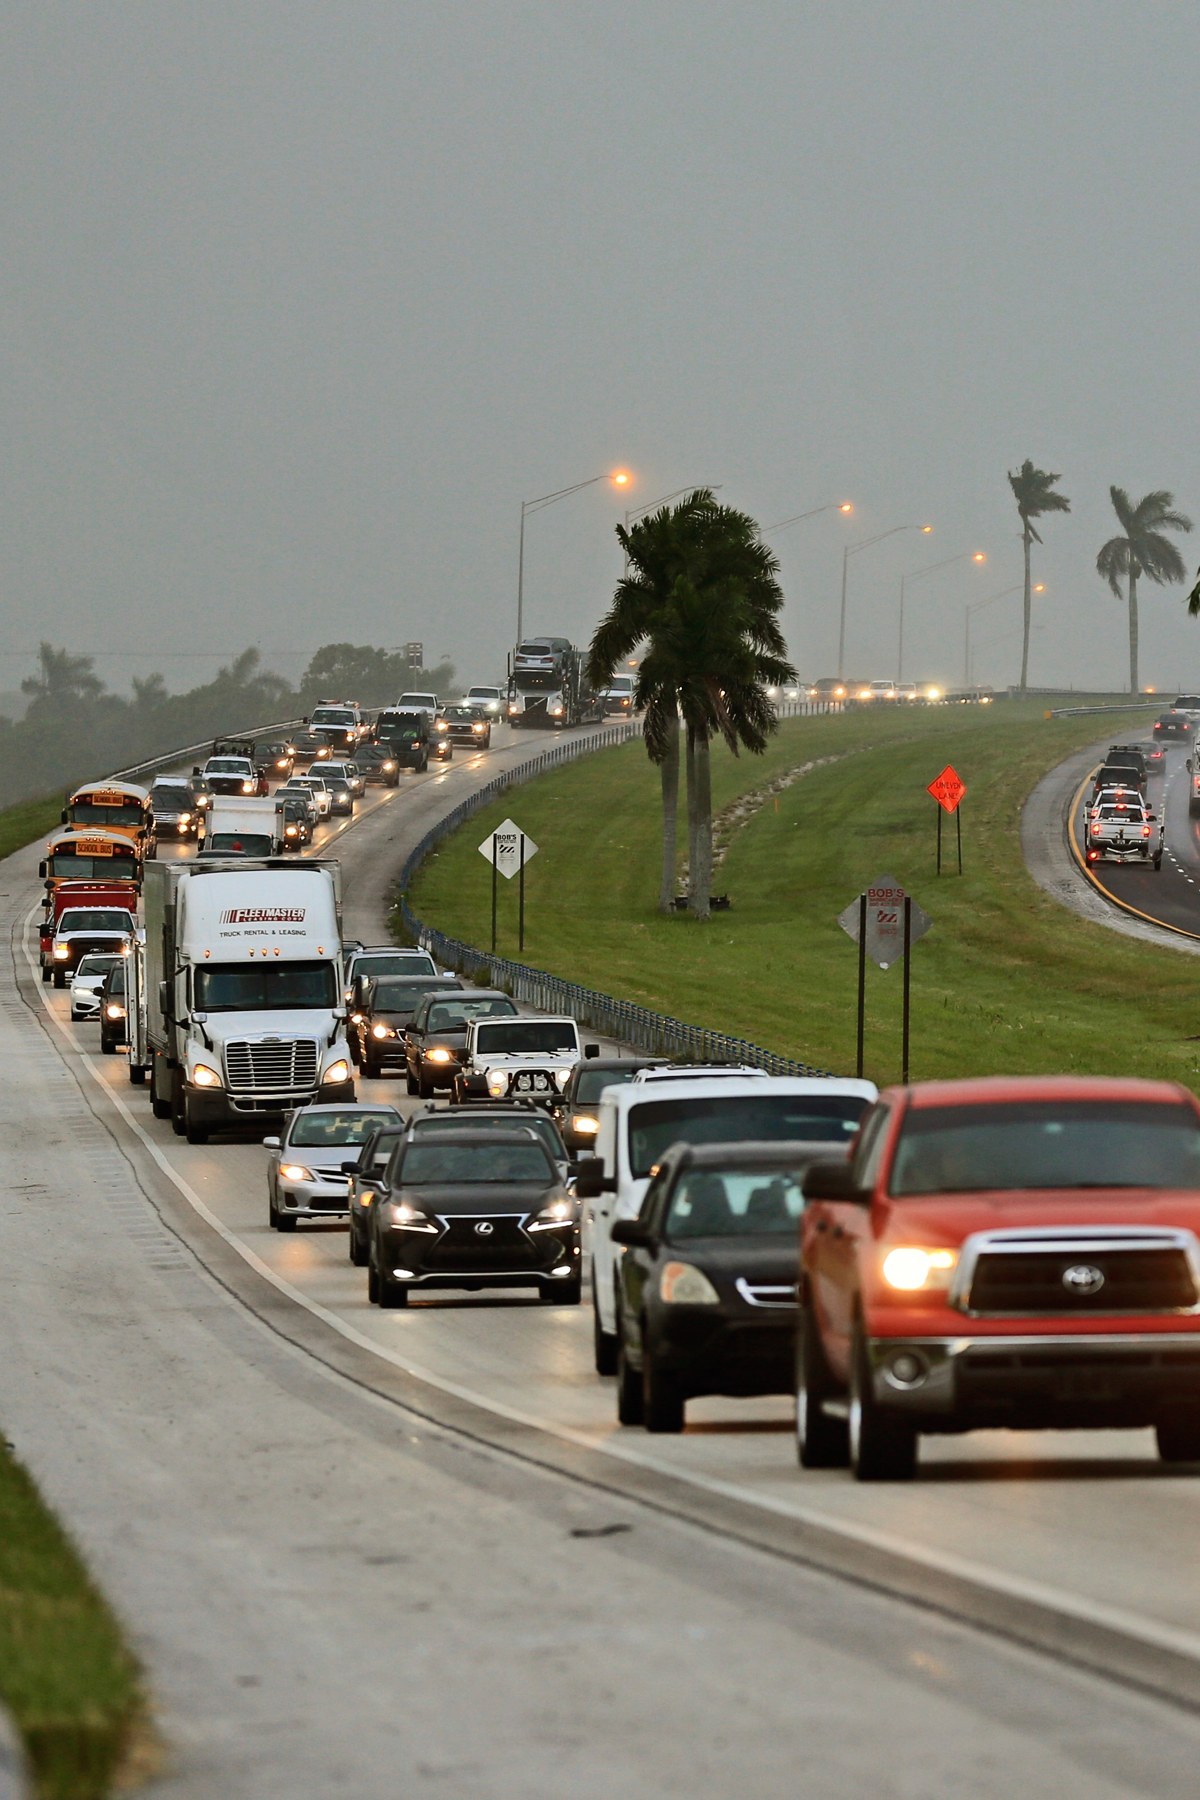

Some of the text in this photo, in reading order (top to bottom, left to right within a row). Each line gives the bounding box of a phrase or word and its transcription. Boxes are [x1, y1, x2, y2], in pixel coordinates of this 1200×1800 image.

[77, 843, 112, 854] SCHOOL BUS
[868, 888, 904, 897] BOB'S
[236, 908, 305, 922] FLEETMASTER
